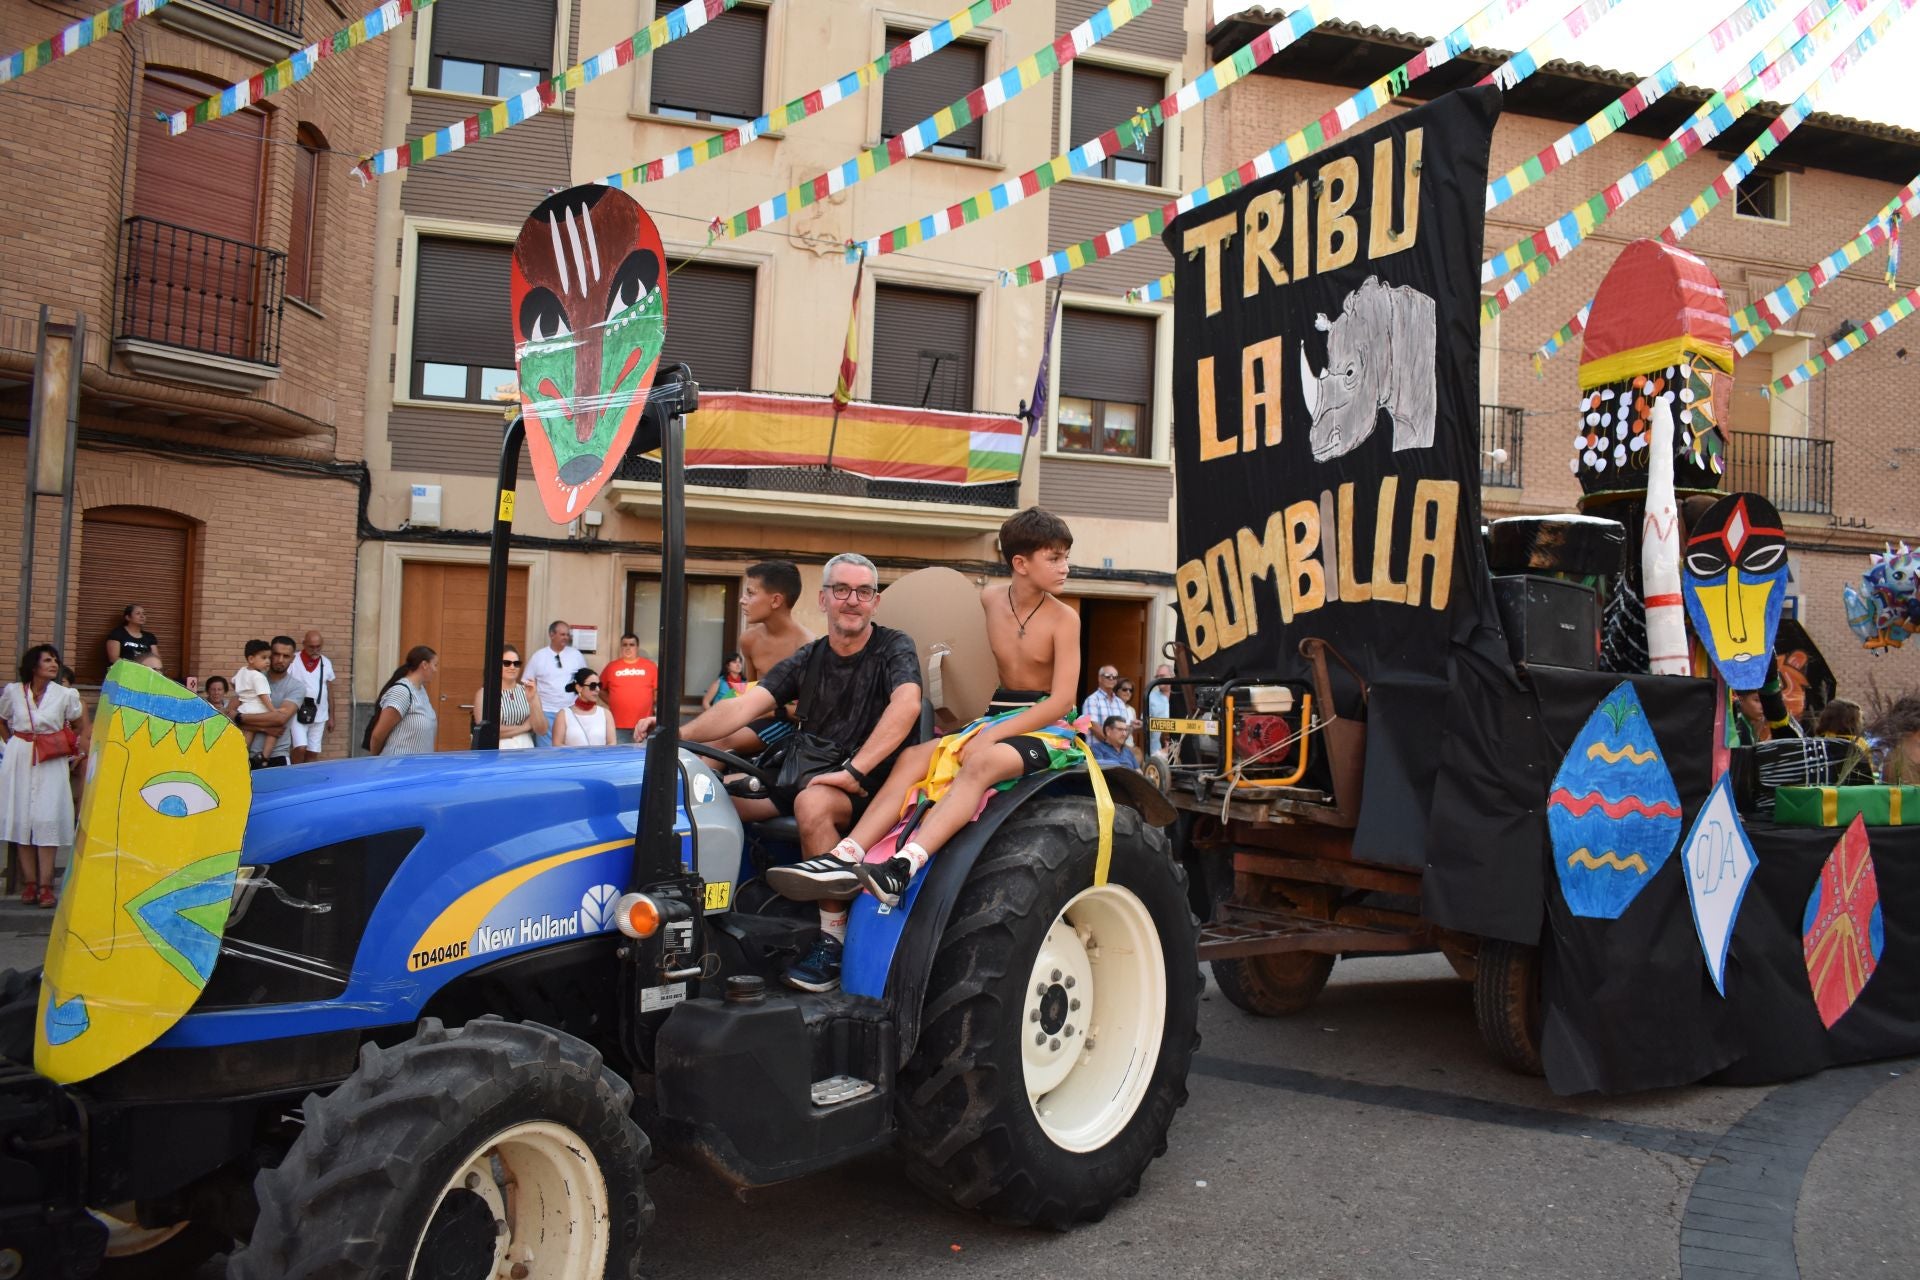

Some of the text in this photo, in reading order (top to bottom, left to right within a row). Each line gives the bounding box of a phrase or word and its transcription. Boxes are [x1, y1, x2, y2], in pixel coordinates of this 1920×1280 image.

[1183, 127, 1424, 318] TRIBU
[1197, 335, 1282, 462] LA
[1176, 474, 1460, 664] BOMBILLA
[615, 668, 646, 677] adidas
[1151, 720, 1175, 730] AYERBE
[1696, 820, 1737, 896] CDA
[412, 940, 468, 969] TD4040F
[477, 910, 578, 953] New Holland
